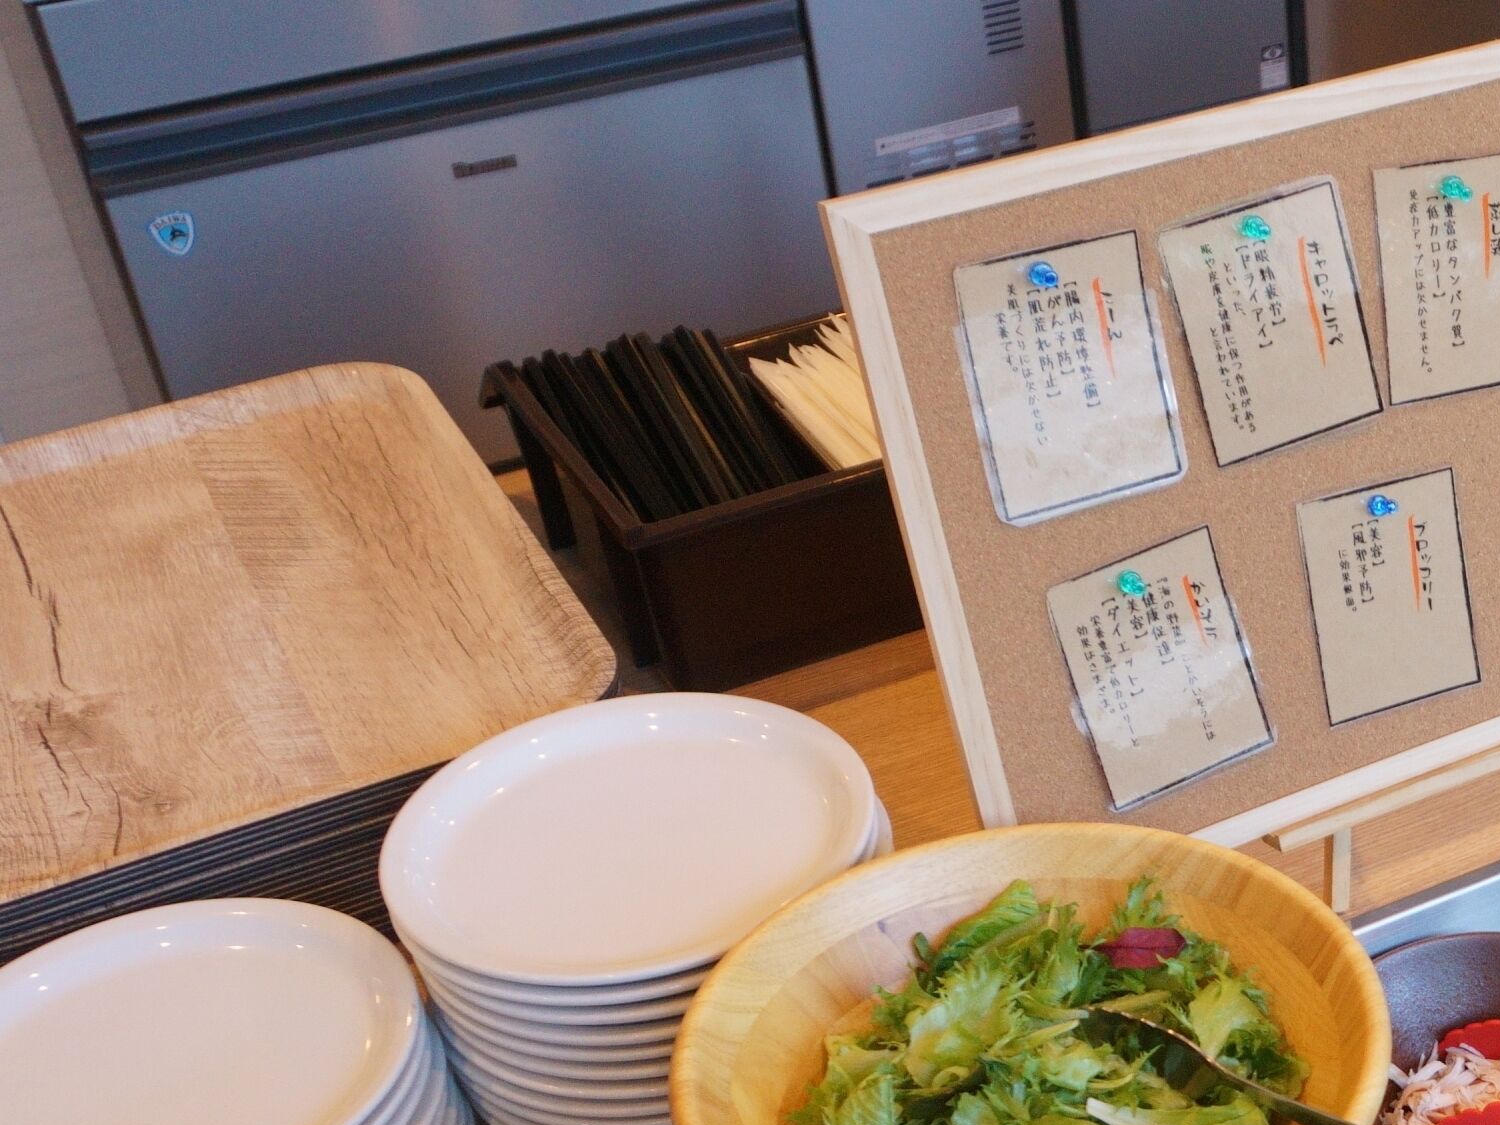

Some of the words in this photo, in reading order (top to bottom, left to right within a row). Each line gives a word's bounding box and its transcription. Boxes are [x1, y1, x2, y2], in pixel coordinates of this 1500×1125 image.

[1306, 241, 1345, 346] キャロットラペ
[1414, 521, 1432, 611] ブロッコリー
